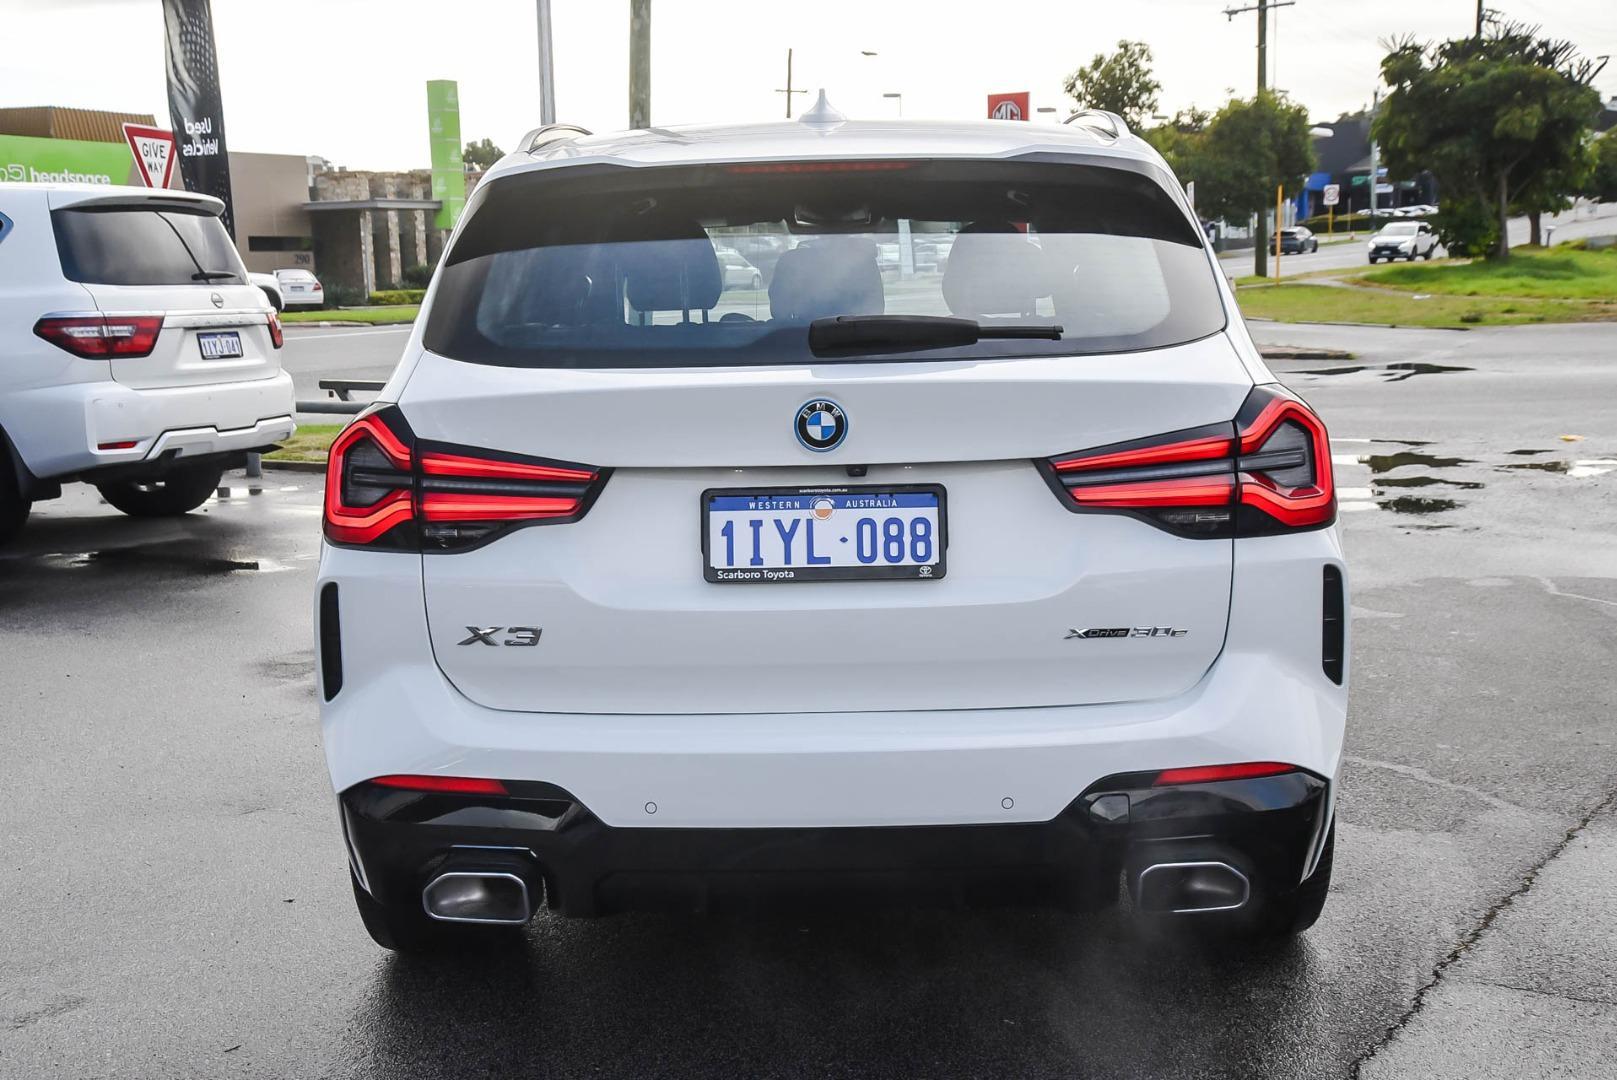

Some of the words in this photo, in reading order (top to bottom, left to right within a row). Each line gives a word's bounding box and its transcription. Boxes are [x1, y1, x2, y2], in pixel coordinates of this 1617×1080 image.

[142, 142, 166, 159] GIVE
[147, 161, 163, 173] WAY
[30, 167, 111, 184] headspace
[802, 403, 841, 419] BMW
[749, 501, 800, 510] WESTERN
[846, 499, 898, 508] AUSTRALIA
[717, 570, 761, 579] Scarboro
[763, 570, 795, 580] Toyota
[456, 626, 543, 647] X3
